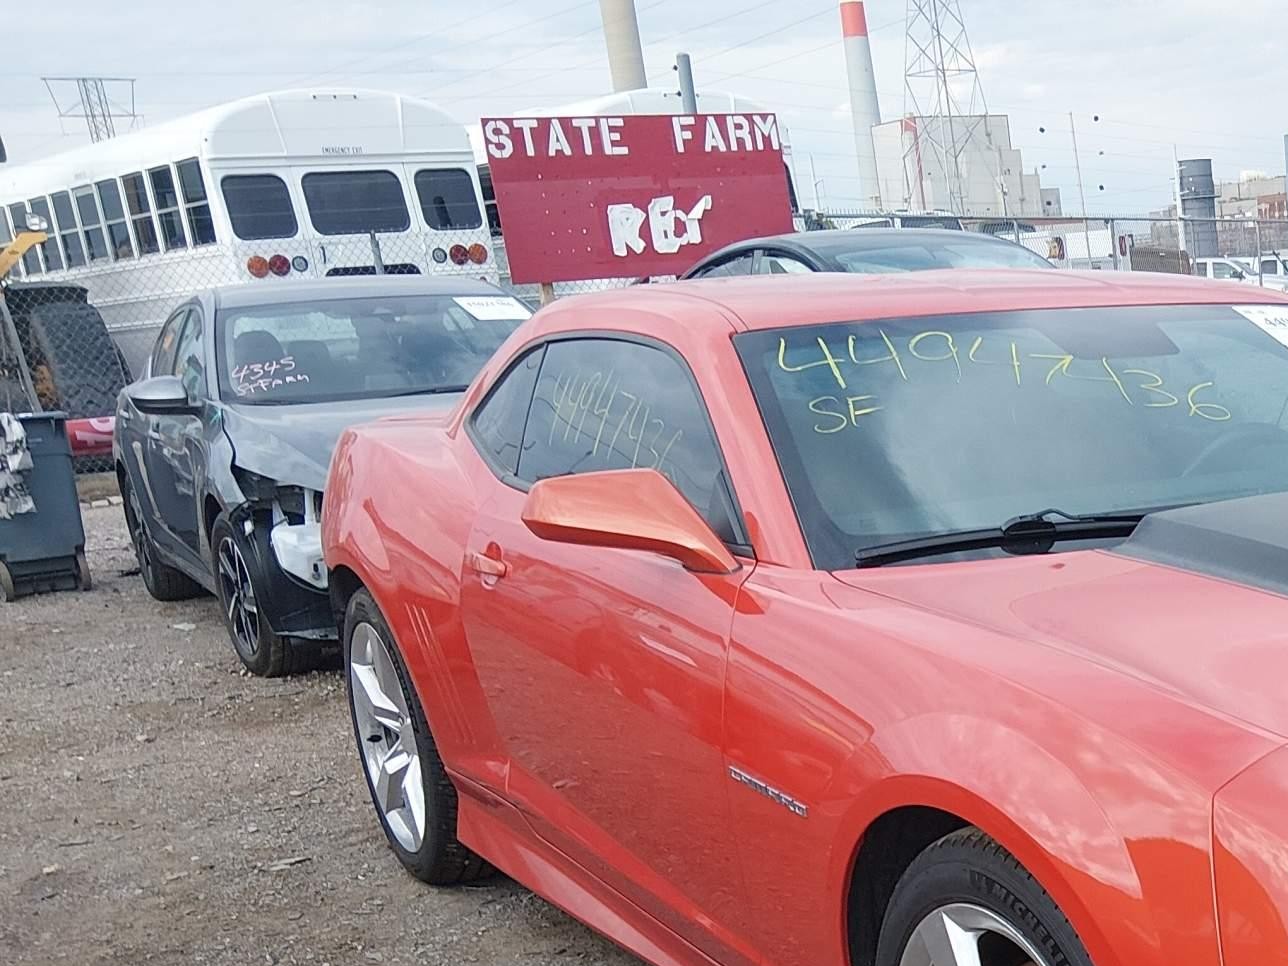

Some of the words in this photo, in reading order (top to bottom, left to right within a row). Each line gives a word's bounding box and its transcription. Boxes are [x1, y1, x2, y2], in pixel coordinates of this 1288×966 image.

[321, 146, 350, 154] EMERGENCY
[485, 117, 629, 158] STATE
[672, 114, 780, 153] FARM
[232, 356, 296, 384] 4345
[808, 395, 885, 434] SF
[728, 766, 809, 818] CAMARO
